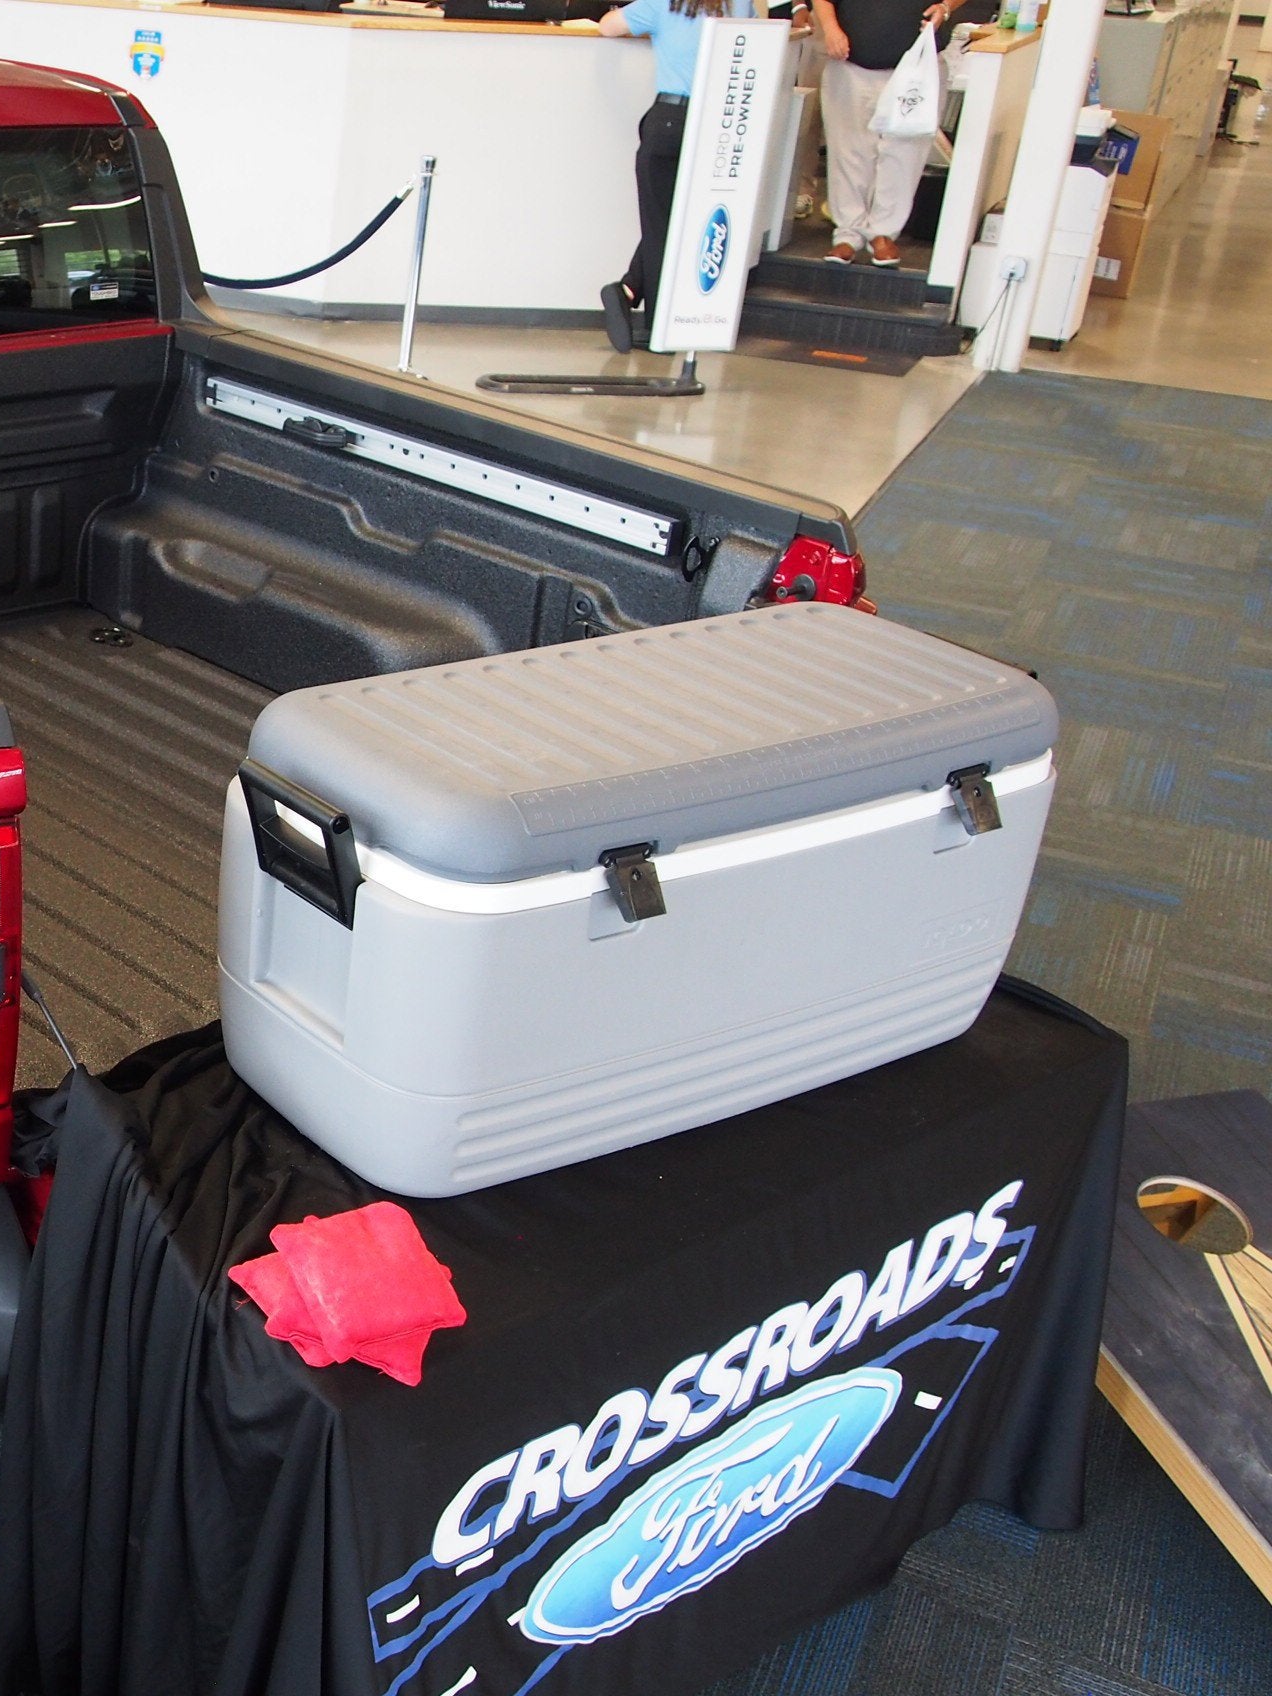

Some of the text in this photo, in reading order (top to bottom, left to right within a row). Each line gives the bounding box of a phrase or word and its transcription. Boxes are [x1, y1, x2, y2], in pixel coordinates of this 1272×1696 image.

[488, 0, 526, 9] ViewSonic
[713, 34, 746, 178] FORD CERTIFIED
[729, 68, 756, 178] PRE-OWNED
[700, 221, 727, 280] Ford
[432, 1179, 1024, 1565] CROSSROADS
[610, 1414, 841, 1611] Ford
